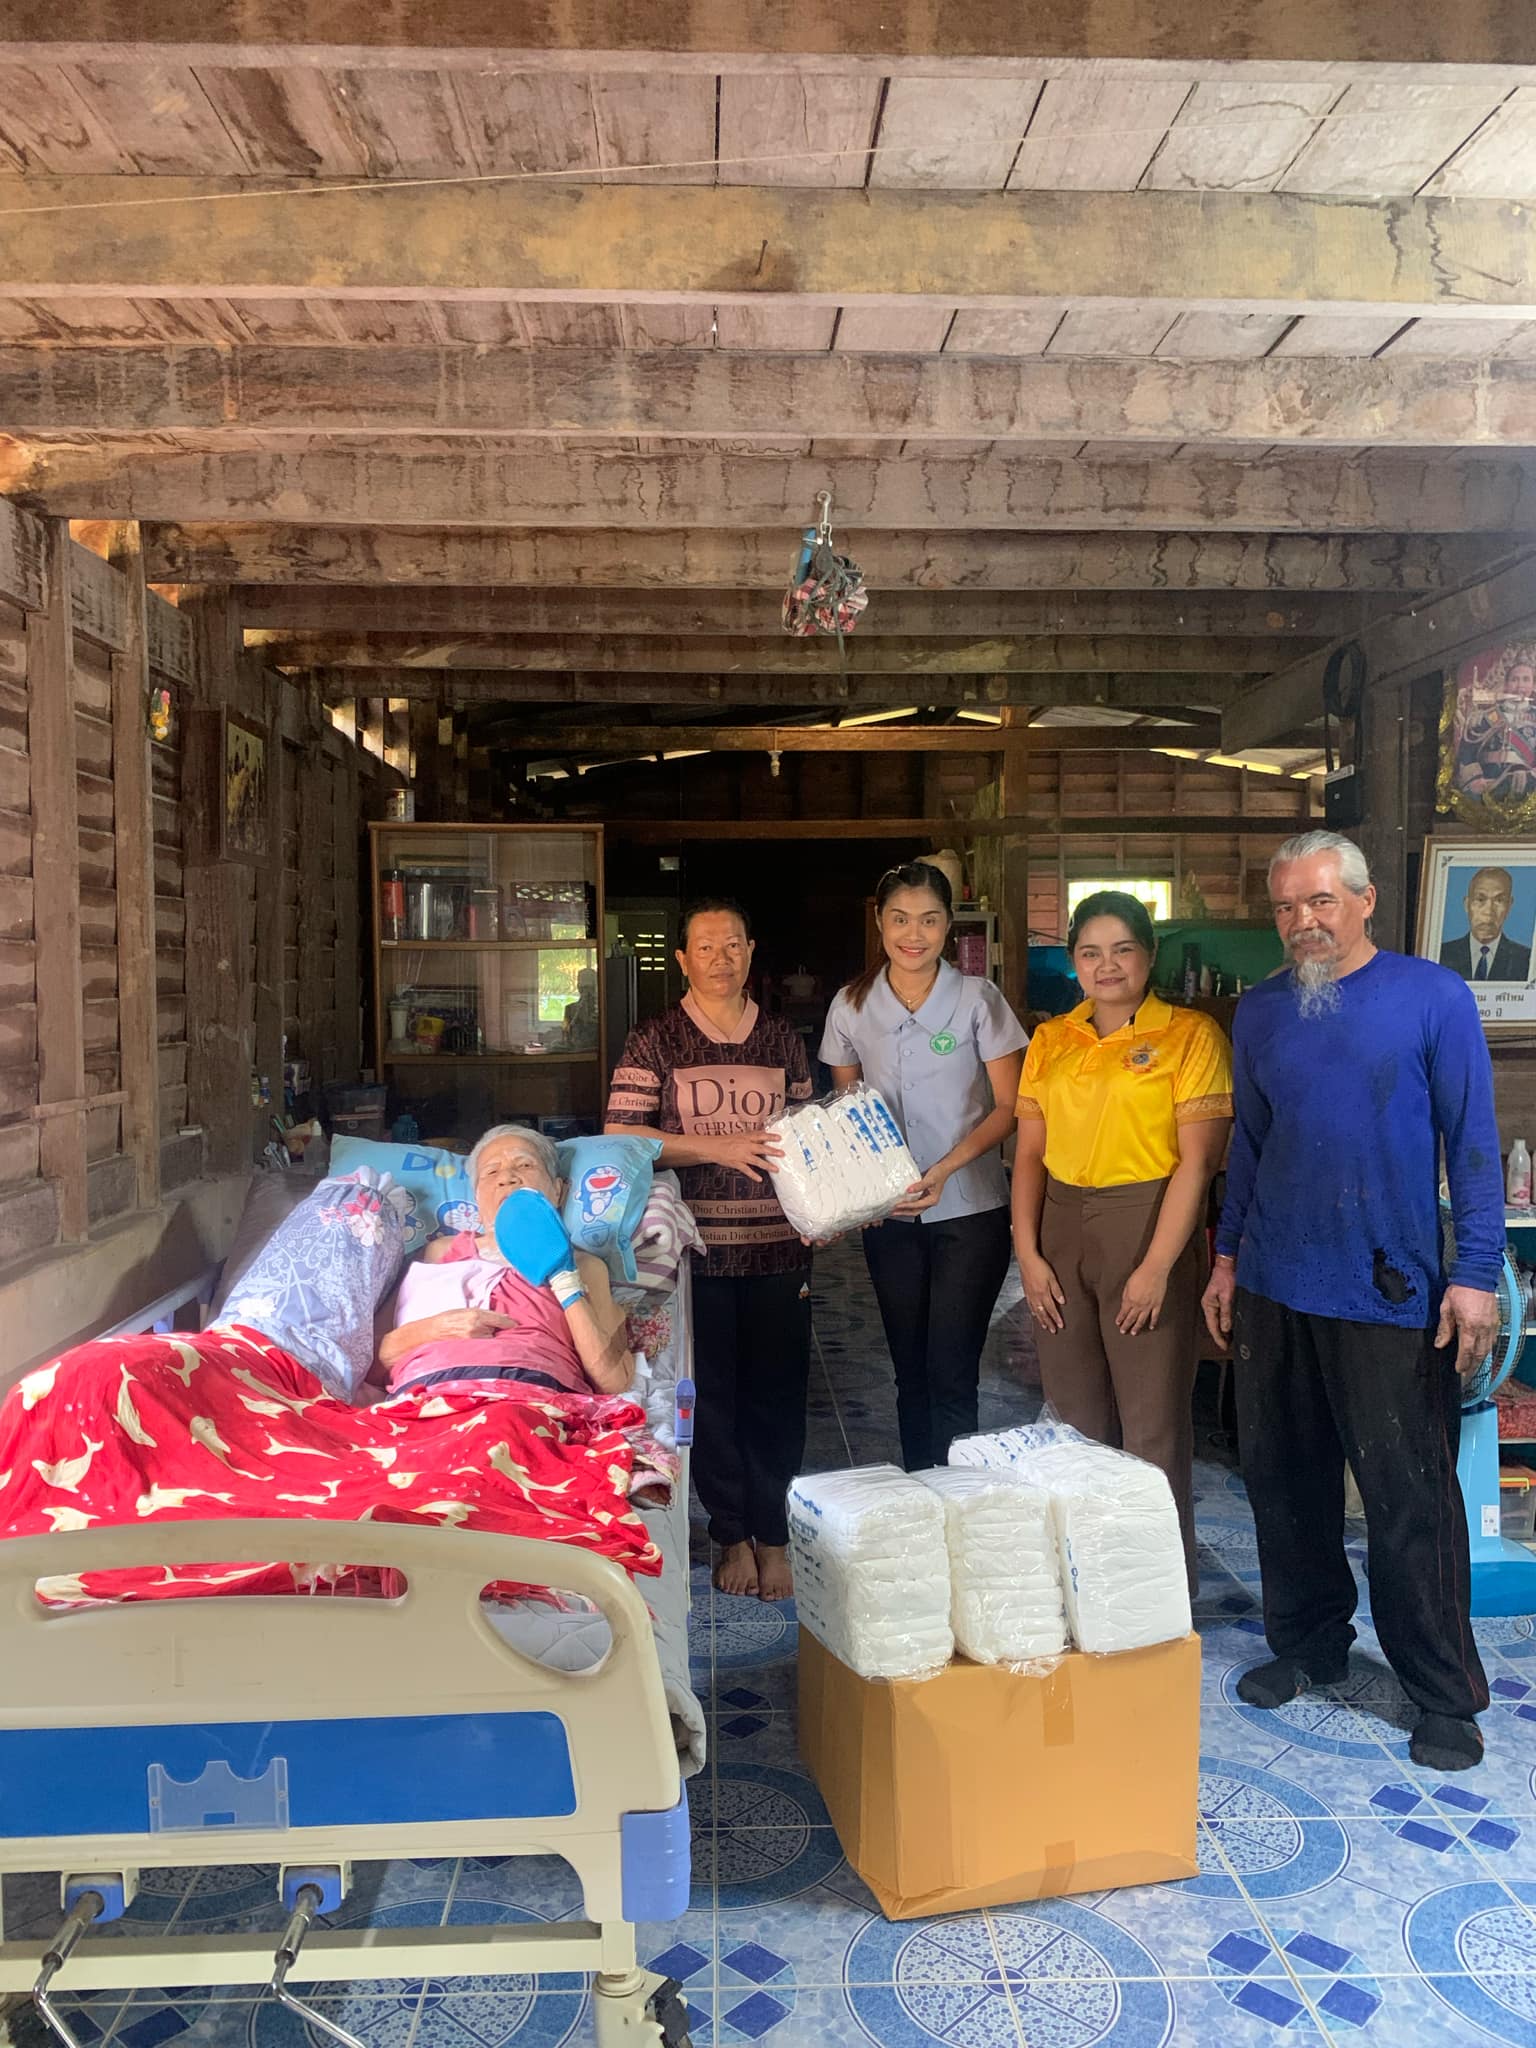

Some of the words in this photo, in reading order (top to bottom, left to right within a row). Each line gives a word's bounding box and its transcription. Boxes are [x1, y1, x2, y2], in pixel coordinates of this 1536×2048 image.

[688, 1078, 782, 1118] Dior
[692, 1204, 713, 1214] Dior
[716, 1204, 758, 1215] Christian
[760, 1203, 780, 1213] Dior
[730, 1231, 752, 1241] Dior
